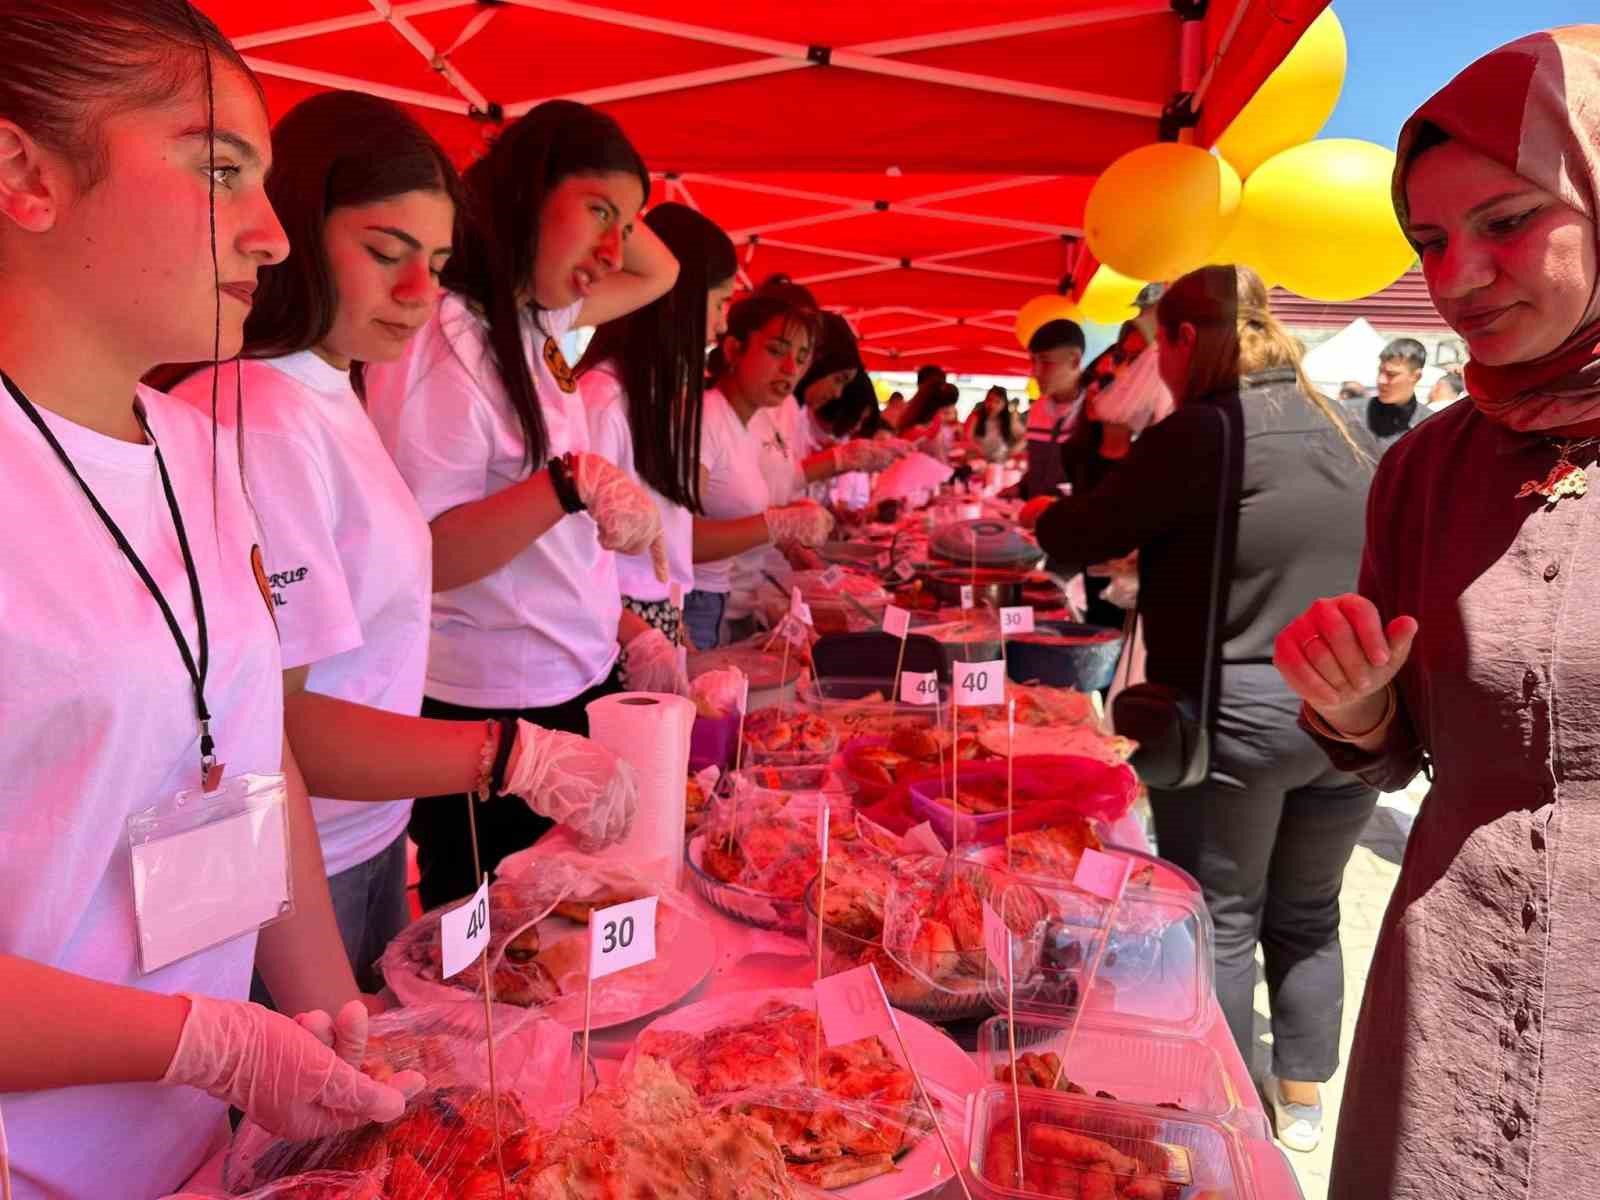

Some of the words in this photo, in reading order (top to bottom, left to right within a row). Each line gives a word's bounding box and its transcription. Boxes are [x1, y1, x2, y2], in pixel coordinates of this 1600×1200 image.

[267, 567, 309, 588] RUP
[1005, 612, 1022, 626] 30
[915, 679, 938, 695] 40
[961, 672, 989, 692] 40
[466, 898, 487, 940] 40
[602, 916, 635, 953] 30
